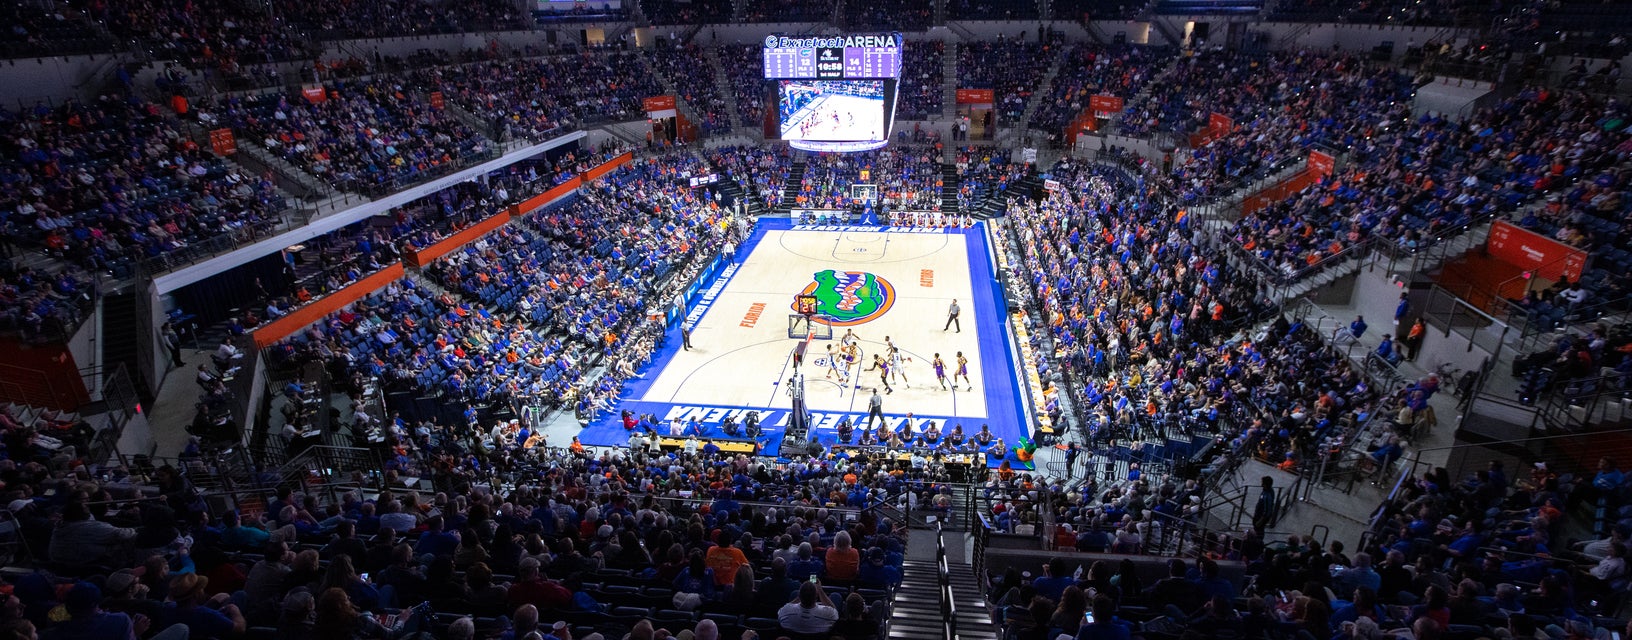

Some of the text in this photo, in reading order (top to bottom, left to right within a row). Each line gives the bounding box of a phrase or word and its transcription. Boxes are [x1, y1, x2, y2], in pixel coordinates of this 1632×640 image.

[779, 36, 896, 48] Exactech ARENA
[817, 63, 843, 71] 10:58
[849, 58, 860, 66] 14
[920, 269, 934, 287] GATORS
[739, 303, 767, 328] FLORIDA
